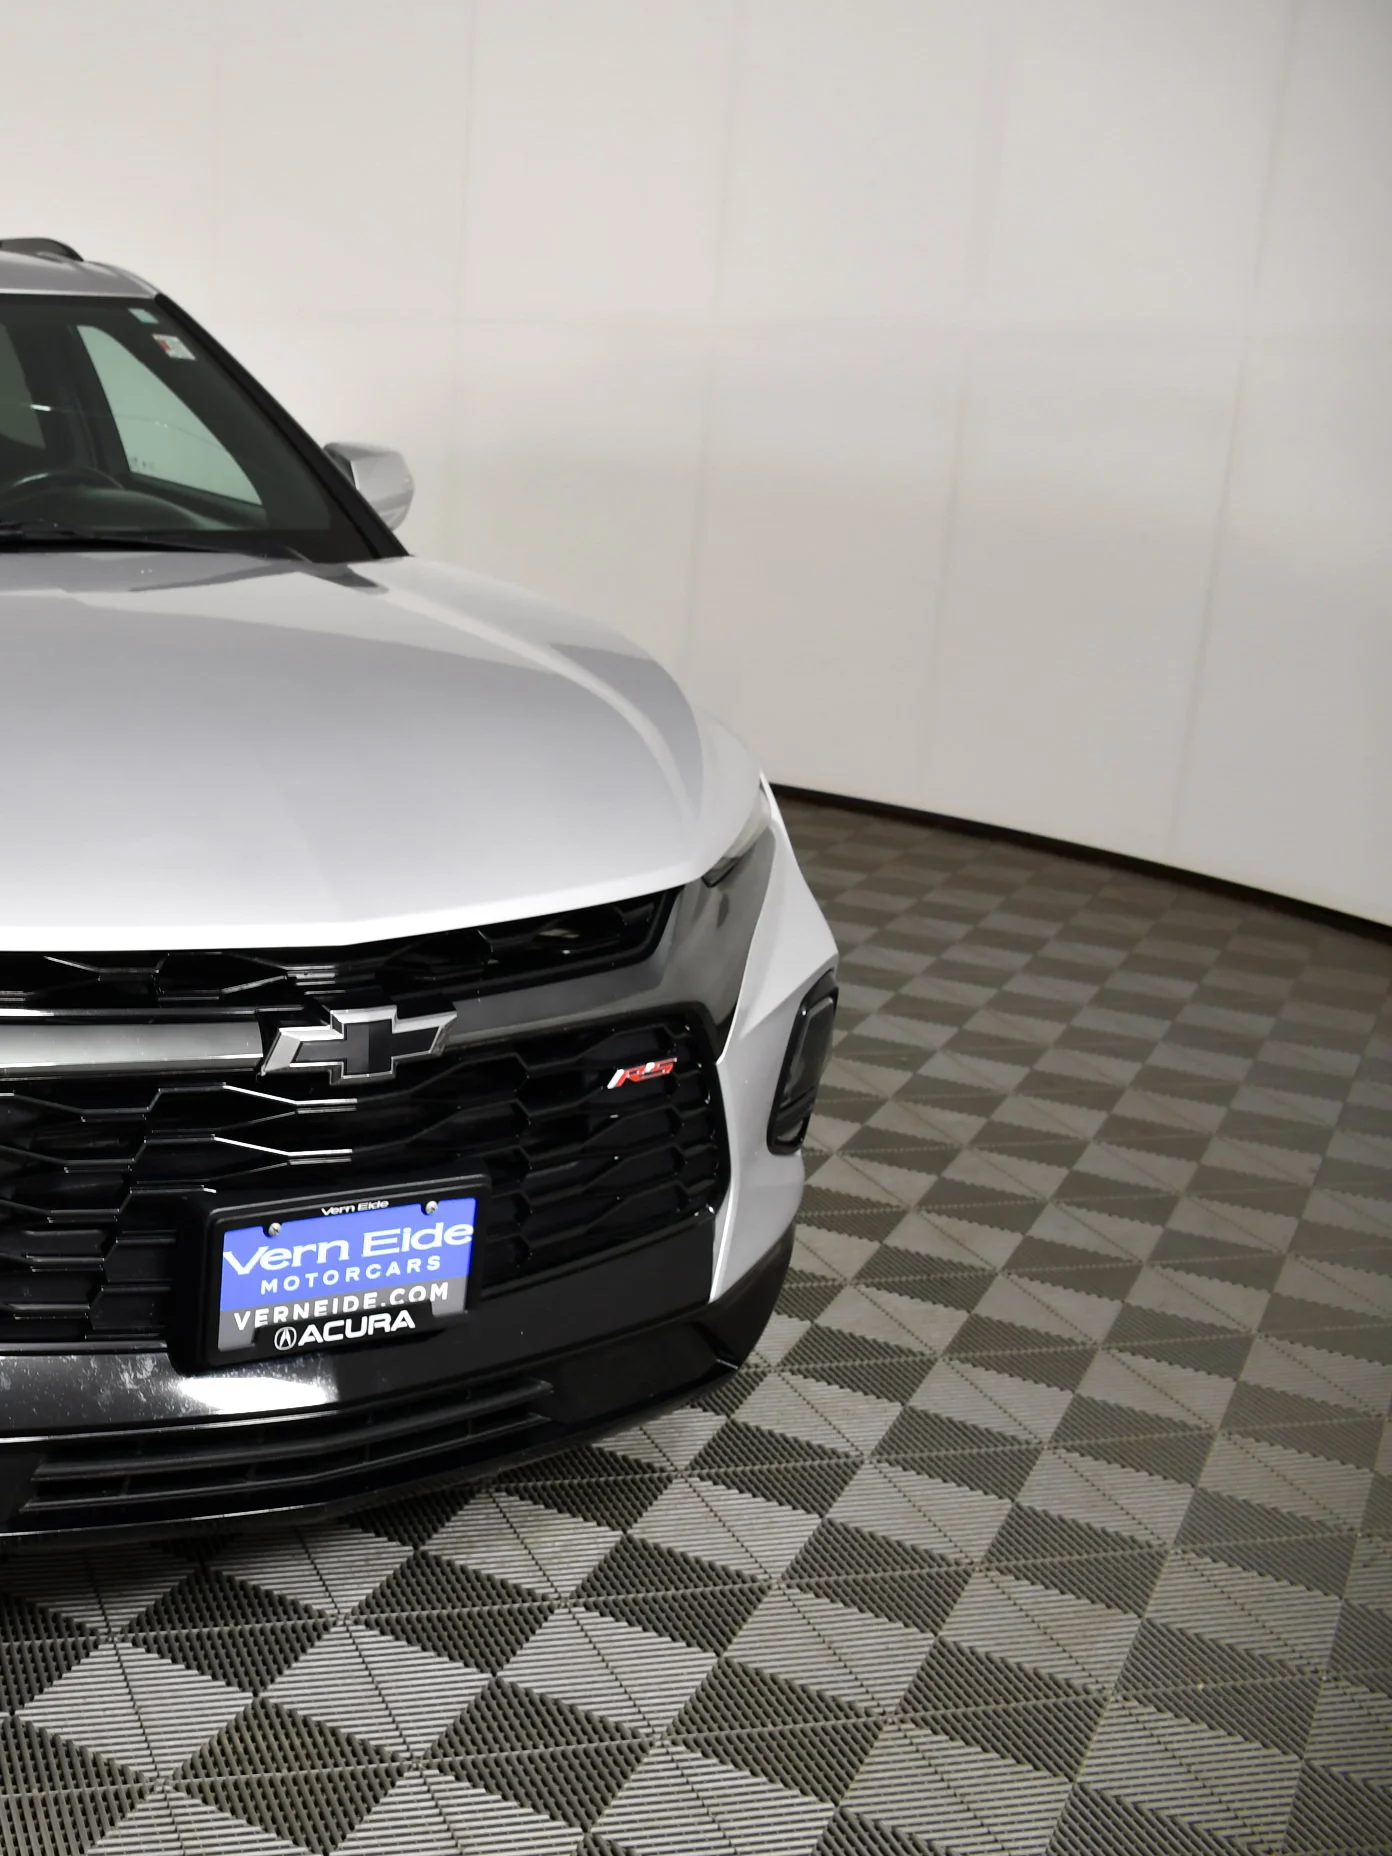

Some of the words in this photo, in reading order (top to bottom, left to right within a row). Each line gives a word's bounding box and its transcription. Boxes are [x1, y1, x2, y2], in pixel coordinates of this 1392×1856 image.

[607, 1057, 677, 1089] RS
[321, 1204, 356, 1216] Vern
[357, 1200, 389, 1212] Eide
[222, 1239, 349, 1276] Vern
[361, 1222, 474, 1257] Eide
[260, 1255, 441, 1295] MOTORCARS
[233, 1281, 449, 1331] VERNEIDE.COM
[297, 1309, 416, 1347] ACURA
